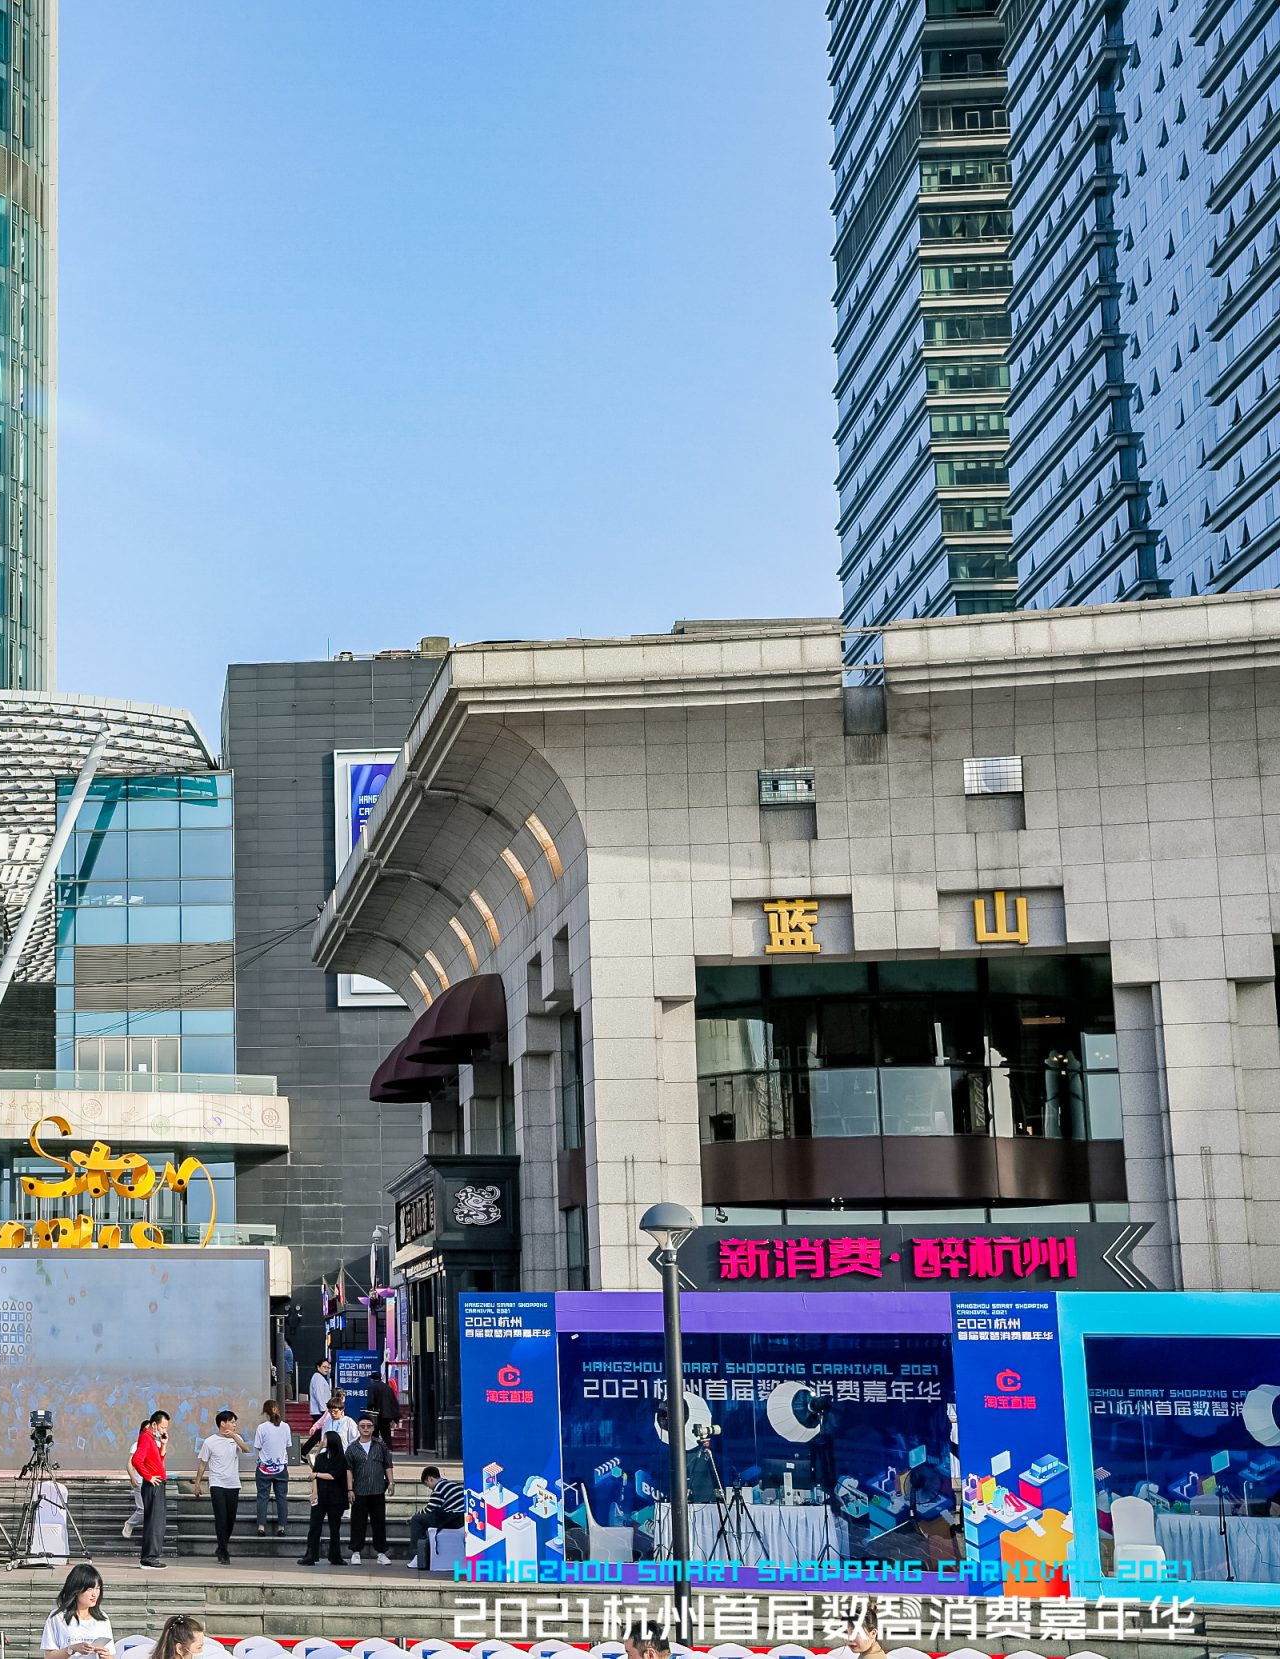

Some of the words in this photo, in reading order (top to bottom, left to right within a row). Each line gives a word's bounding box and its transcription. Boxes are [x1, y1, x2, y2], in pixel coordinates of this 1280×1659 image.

[358, 794, 379, 805] HANG
[358, 807, 373, 816] CA
[764, 891, 1028, 954] 蓝山
[718, 1236, 1078, 1279] 新消费·醉杭州
[464, 1316, 523, 1328] 2021杭州
[957, 1318, 1021, 1330] 2021杭州
[582, 1361, 663, 1373] HANGZHOU
[681, 1362, 719, 1374] MART
[725, 1363, 806, 1375] SHOPPING
[812, 1363, 894, 1375] CARNIVAL
[900, 1364, 939, 1376] 2021
[486, 1389, 534, 1404] 淘宝直播
[583, 1378, 941, 1403] 2021杭州首届数消费嘉年华
[1128, 1388, 1164, 1397] SMART
[1169, 1389, 1227, 1398] SHOPPING
[984, 1395, 1037, 1409] 淘宝直播
